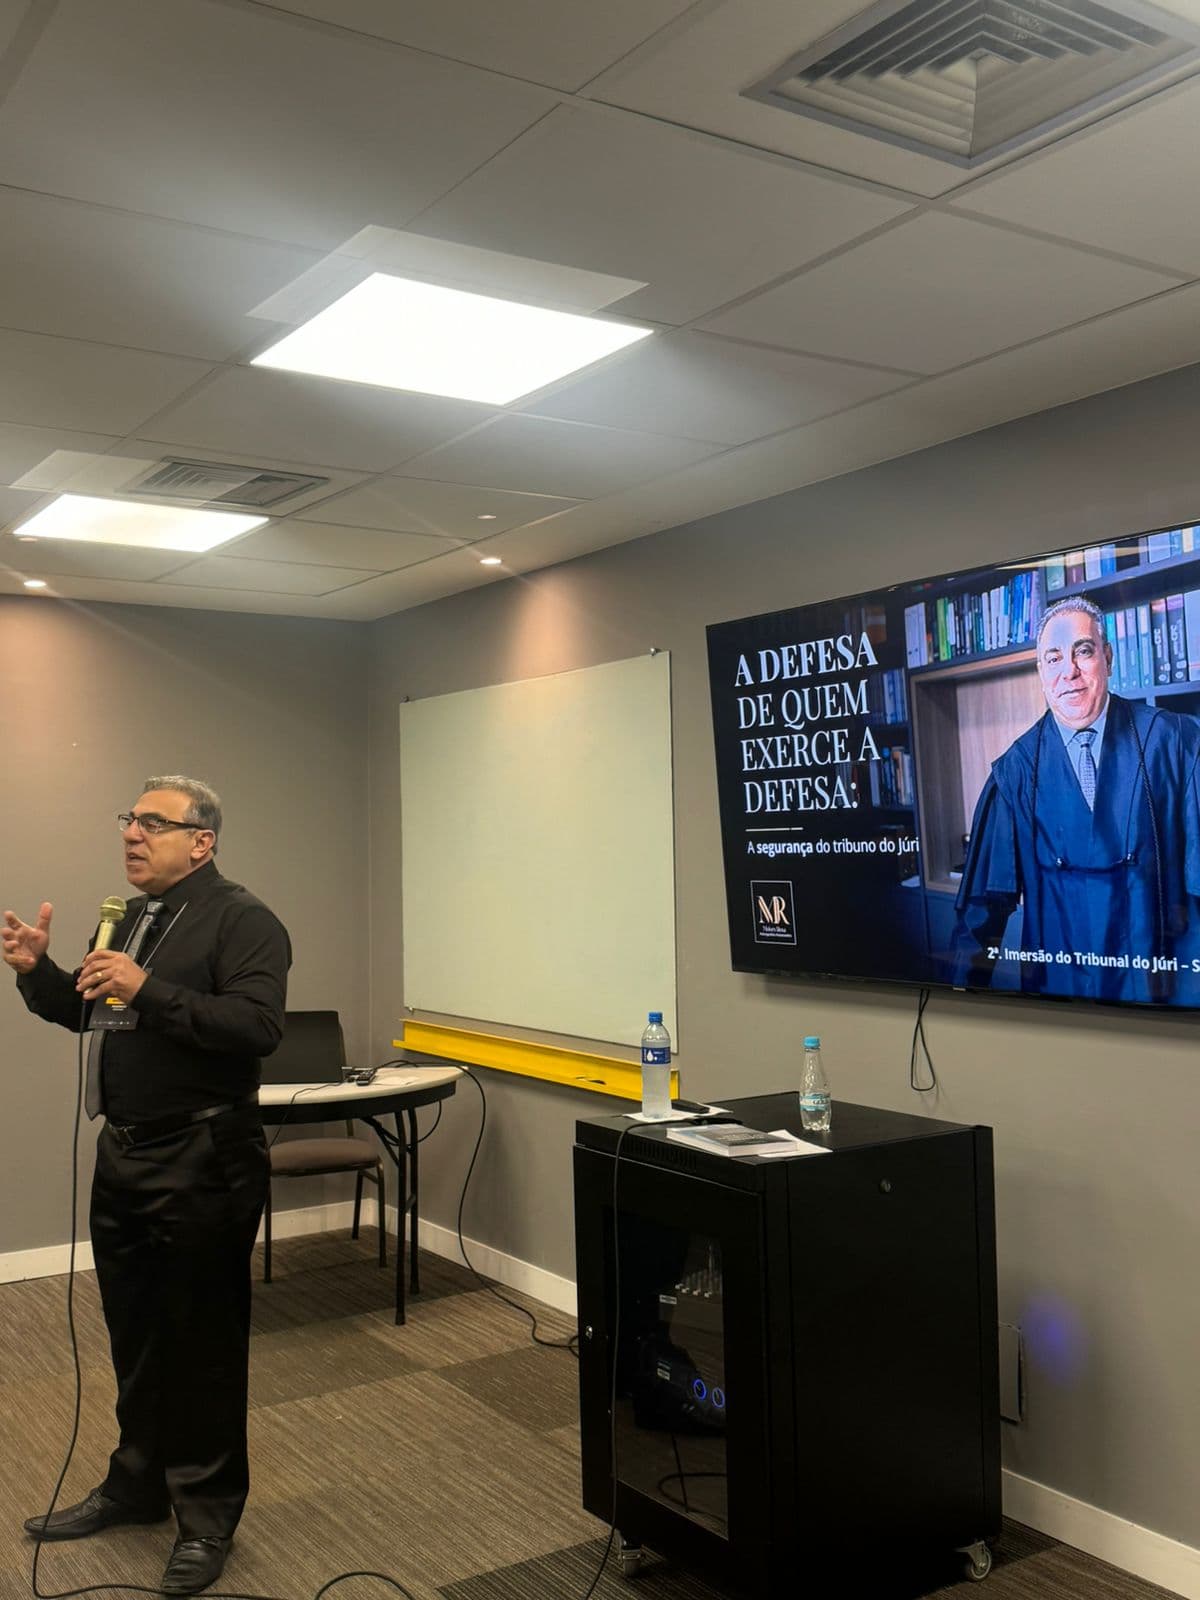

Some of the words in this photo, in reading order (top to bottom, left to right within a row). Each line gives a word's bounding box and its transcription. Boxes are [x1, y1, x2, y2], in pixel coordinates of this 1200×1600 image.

[734, 654, 754, 687] A
[758, 631, 878, 684] DEFESA
[737, 694, 775, 730] DE
[781, 679, 870, 730] QUEM
[740, 728, 851, 772] EXERCE
[858, 726, 881, 762] A
[743, 775, 858, 814] DEFESA:
[747, 841, 755, 854] A
[757, 841, 813, 858] segurança
[816, 838, 831, 854] do
[833, 838, 876, 854] tribuno
[879, 837, 895, 853] do
[897, 836, 920, 855] Júri
[1004, 948, 1053, 963] Imersão
[1055, 951, 1072, 964] do
[1074, 951, 1129, 968] Tribunal
[1132, 955, 1150, 970] do
[1151, 956, 1178, 974] Júri
